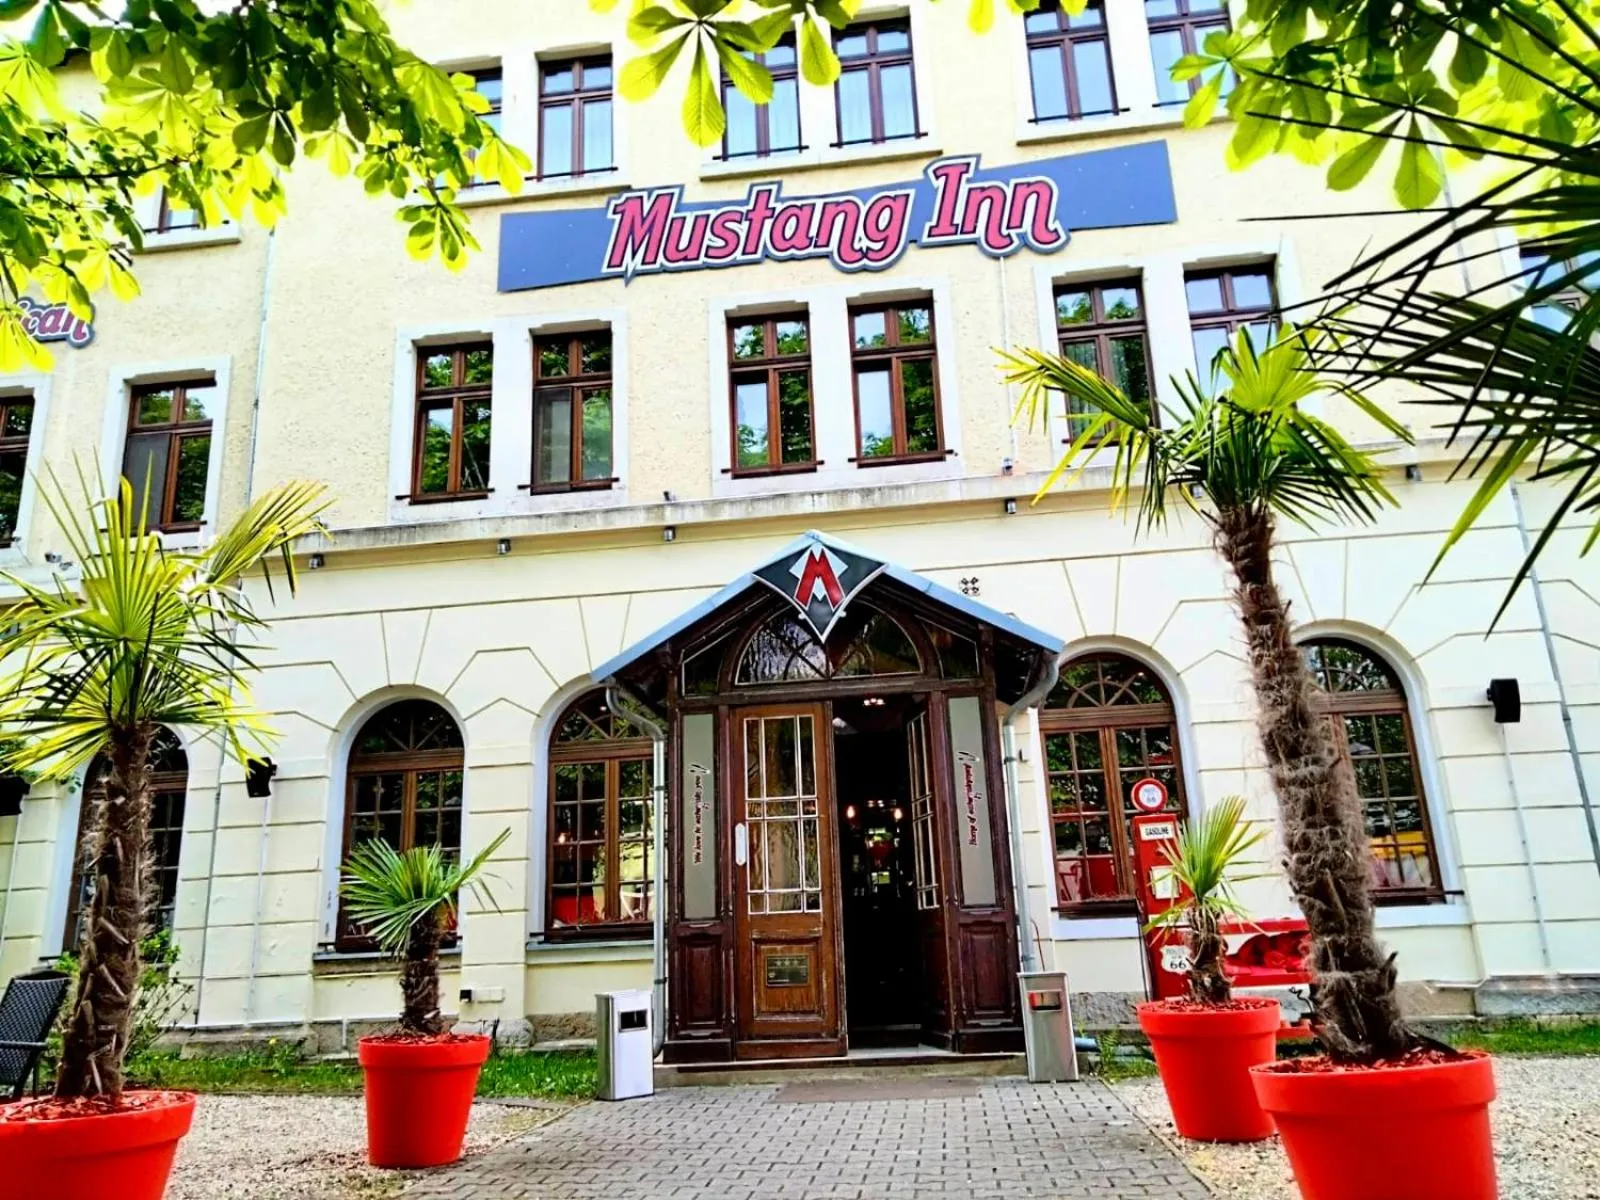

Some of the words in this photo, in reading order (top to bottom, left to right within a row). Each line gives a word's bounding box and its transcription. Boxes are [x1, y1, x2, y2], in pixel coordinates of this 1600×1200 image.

[605, 188, 911, 263] Mustang
[927, 161, 1061, 250] Inn
[793, 547, 846, 612] M
[1144, 826, 1169, 837] GASOLINE
[1169, 960, 1187, 970] 66
